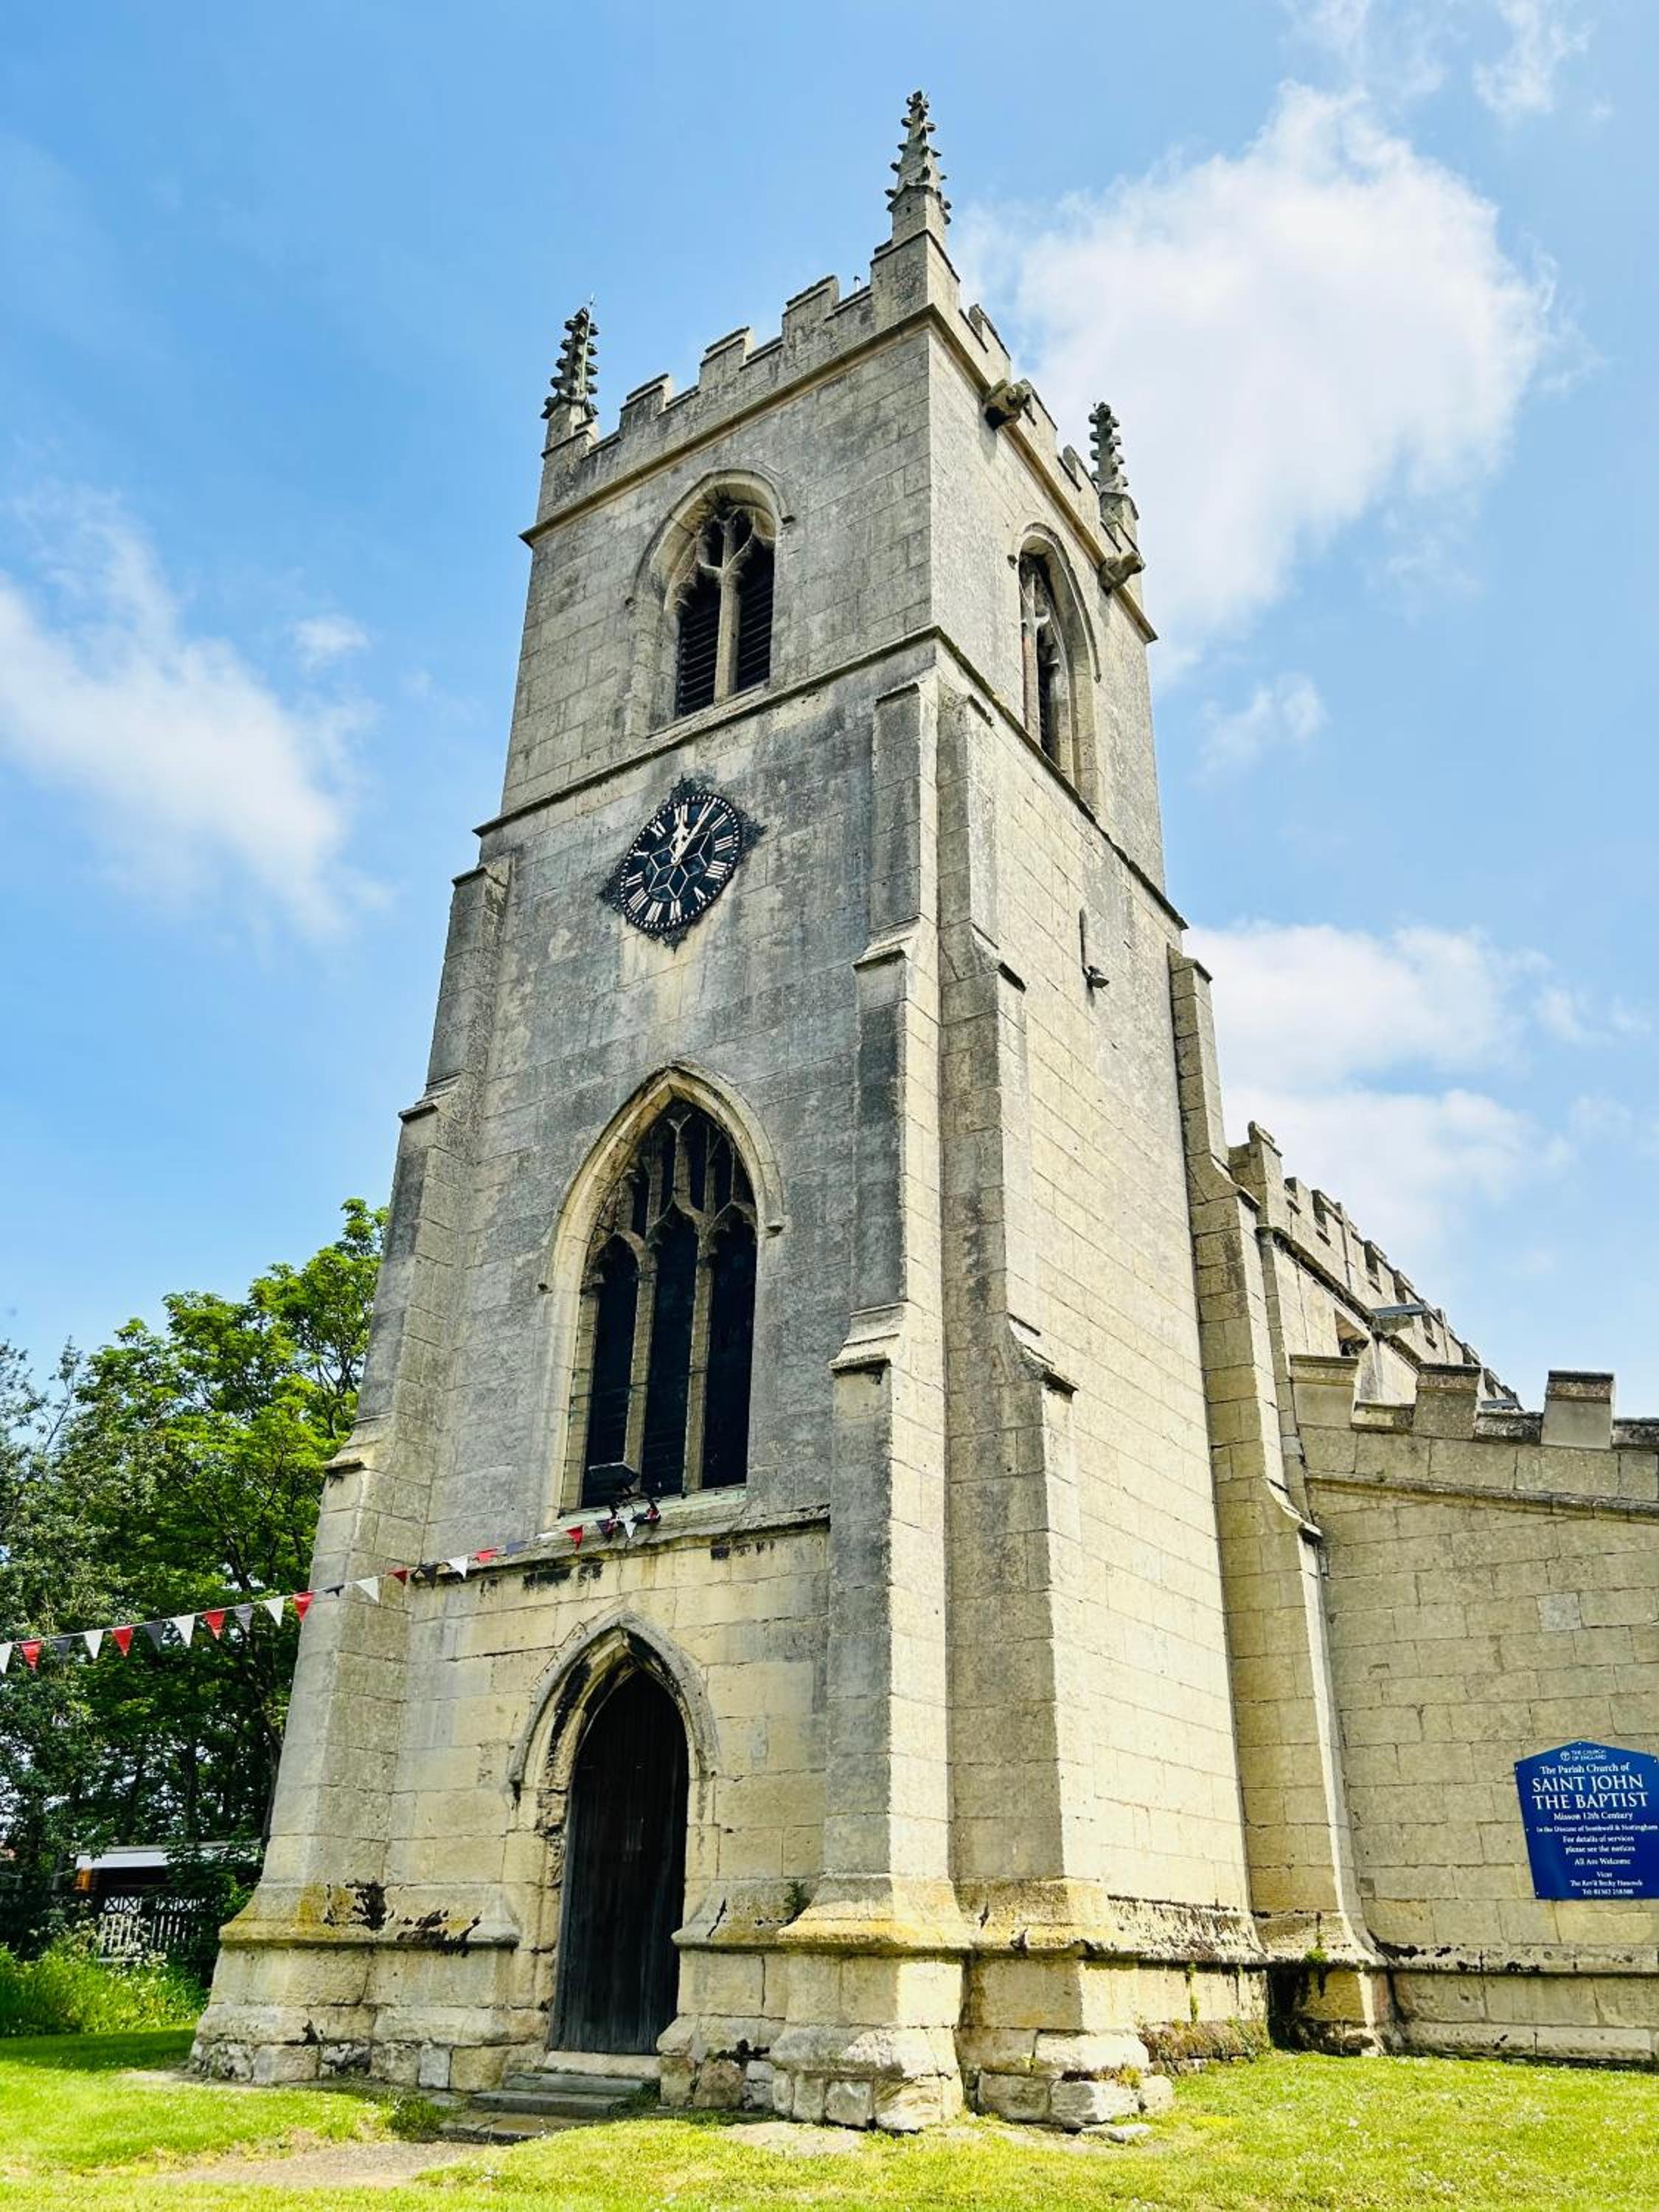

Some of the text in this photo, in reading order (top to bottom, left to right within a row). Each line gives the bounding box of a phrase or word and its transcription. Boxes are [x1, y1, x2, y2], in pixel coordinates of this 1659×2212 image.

[650, 820, 666, 840] XI
[709, 812, 728, 832] II
[714, 835, 734, 852] III
[633, 848, 650, 859] X
[704, 860, 728, 879] IIII
[628, 887, 650, 914] VIII
[694, 886, 706, 902] V
[1540, 1761, 1630, 1775] The Parish Church of
[1532, 1774, 1644, 1793] SAINT JOHN
[1531, 1792, 1649, 1810] THE BAPTIST
[1554, 1811, 1633, 1820] Misson 12th Century
[1621, 1823, 1658, 1832] Nottingham
[1599, 1834, 1607, 1843] of
[1565, 1845, 1586, 1854] please
[1574, 1857, 1585, 1865] All
